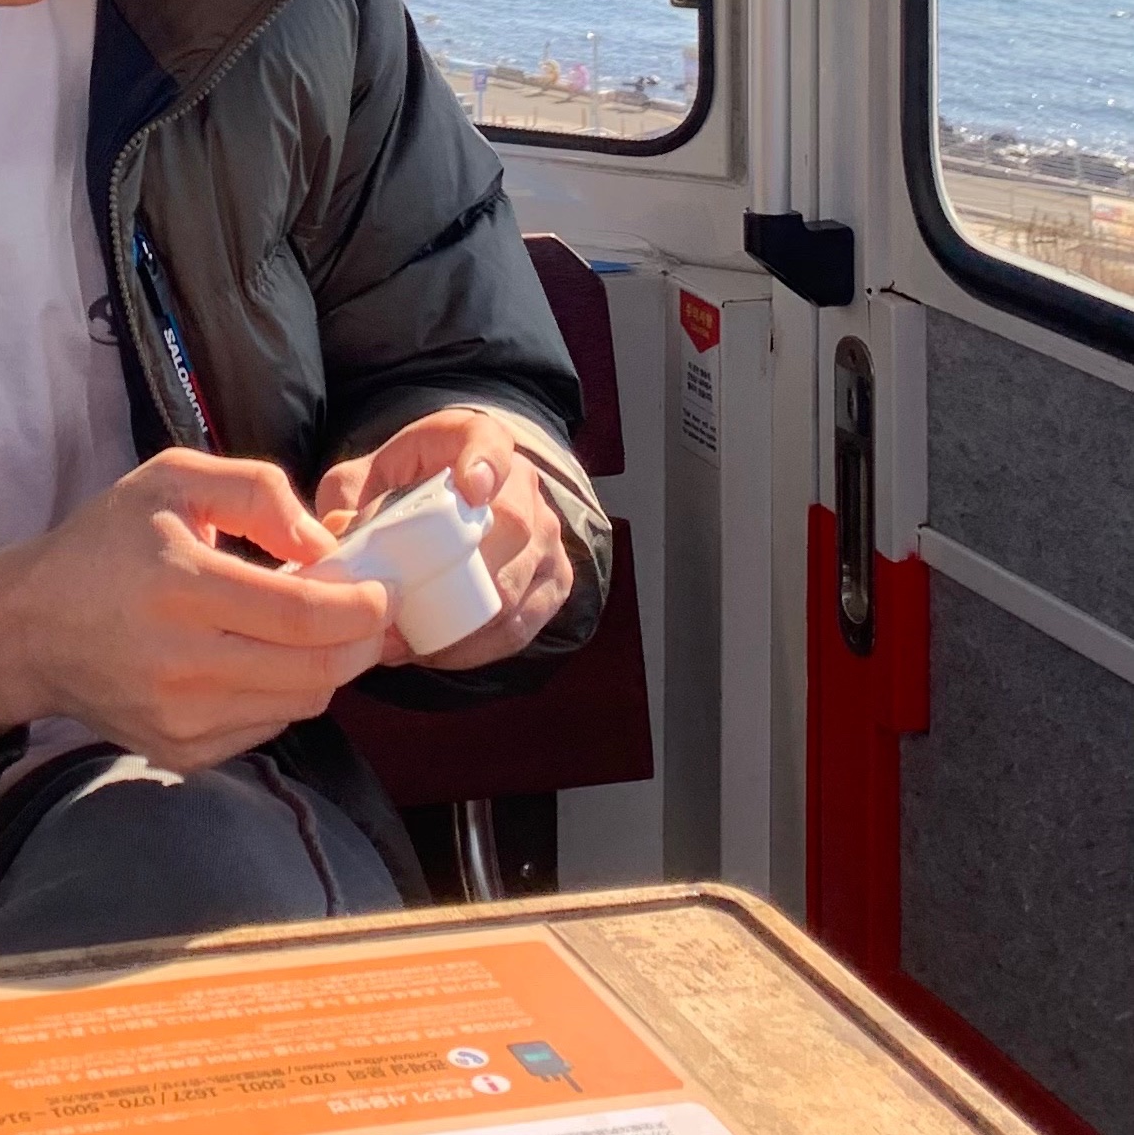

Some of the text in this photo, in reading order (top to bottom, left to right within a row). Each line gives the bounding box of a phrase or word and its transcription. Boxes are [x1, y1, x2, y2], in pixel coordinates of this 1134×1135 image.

[163, 327, 209, 434] SALOMON
[390, 1052, 437, 1062] Control
[300, 1072, 336, 1085] 070
[238, 1080, 286, 1093] 5001
[174, 1087, 218, 1102] 1627
[118, 1096, 155, 1109] 070
[50, 1103, 99, 1118] 5001
